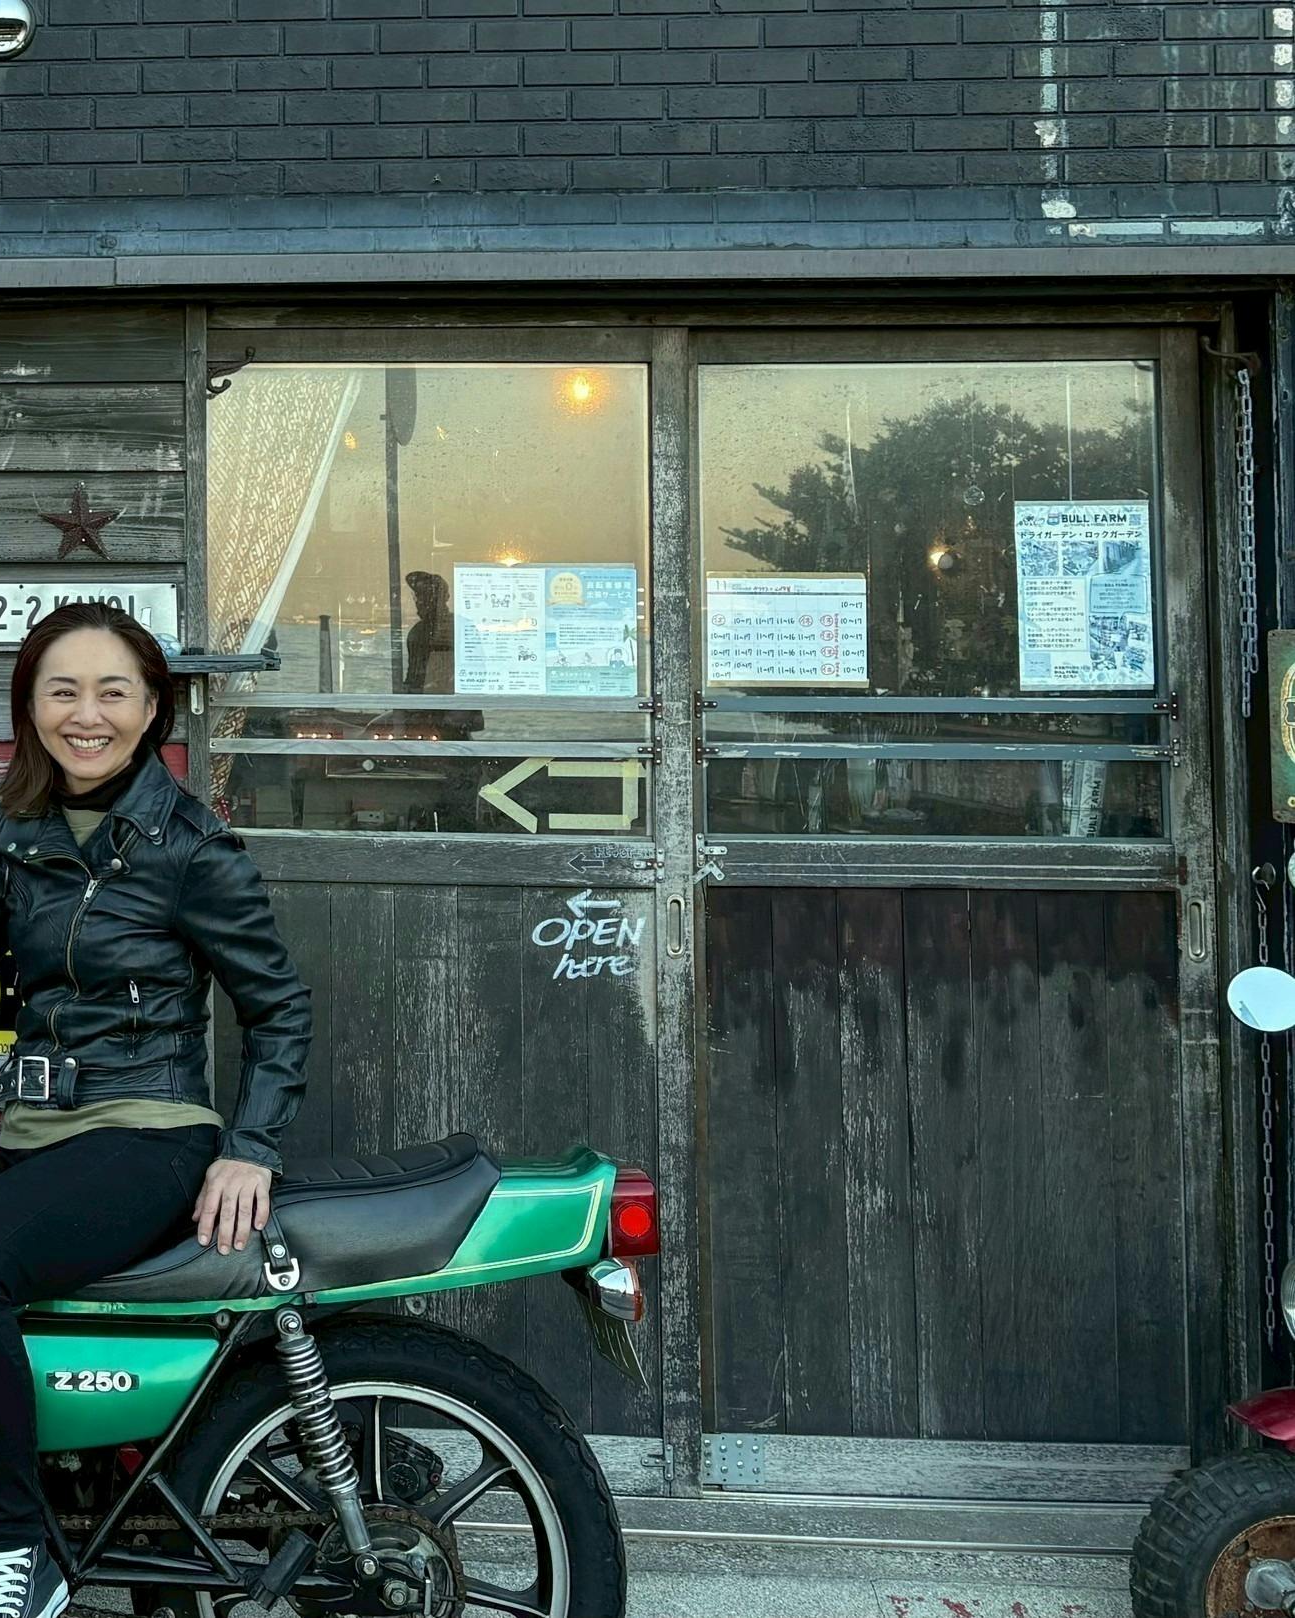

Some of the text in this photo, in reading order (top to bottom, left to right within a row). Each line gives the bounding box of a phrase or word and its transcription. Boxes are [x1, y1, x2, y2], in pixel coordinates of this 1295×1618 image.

[1061, 513, 1127, 523] BULL FARM
[531, 917, 647, 950] OPEN
[553, 953, 635, 980] here
[77, 1370, 132, 1392] 250
